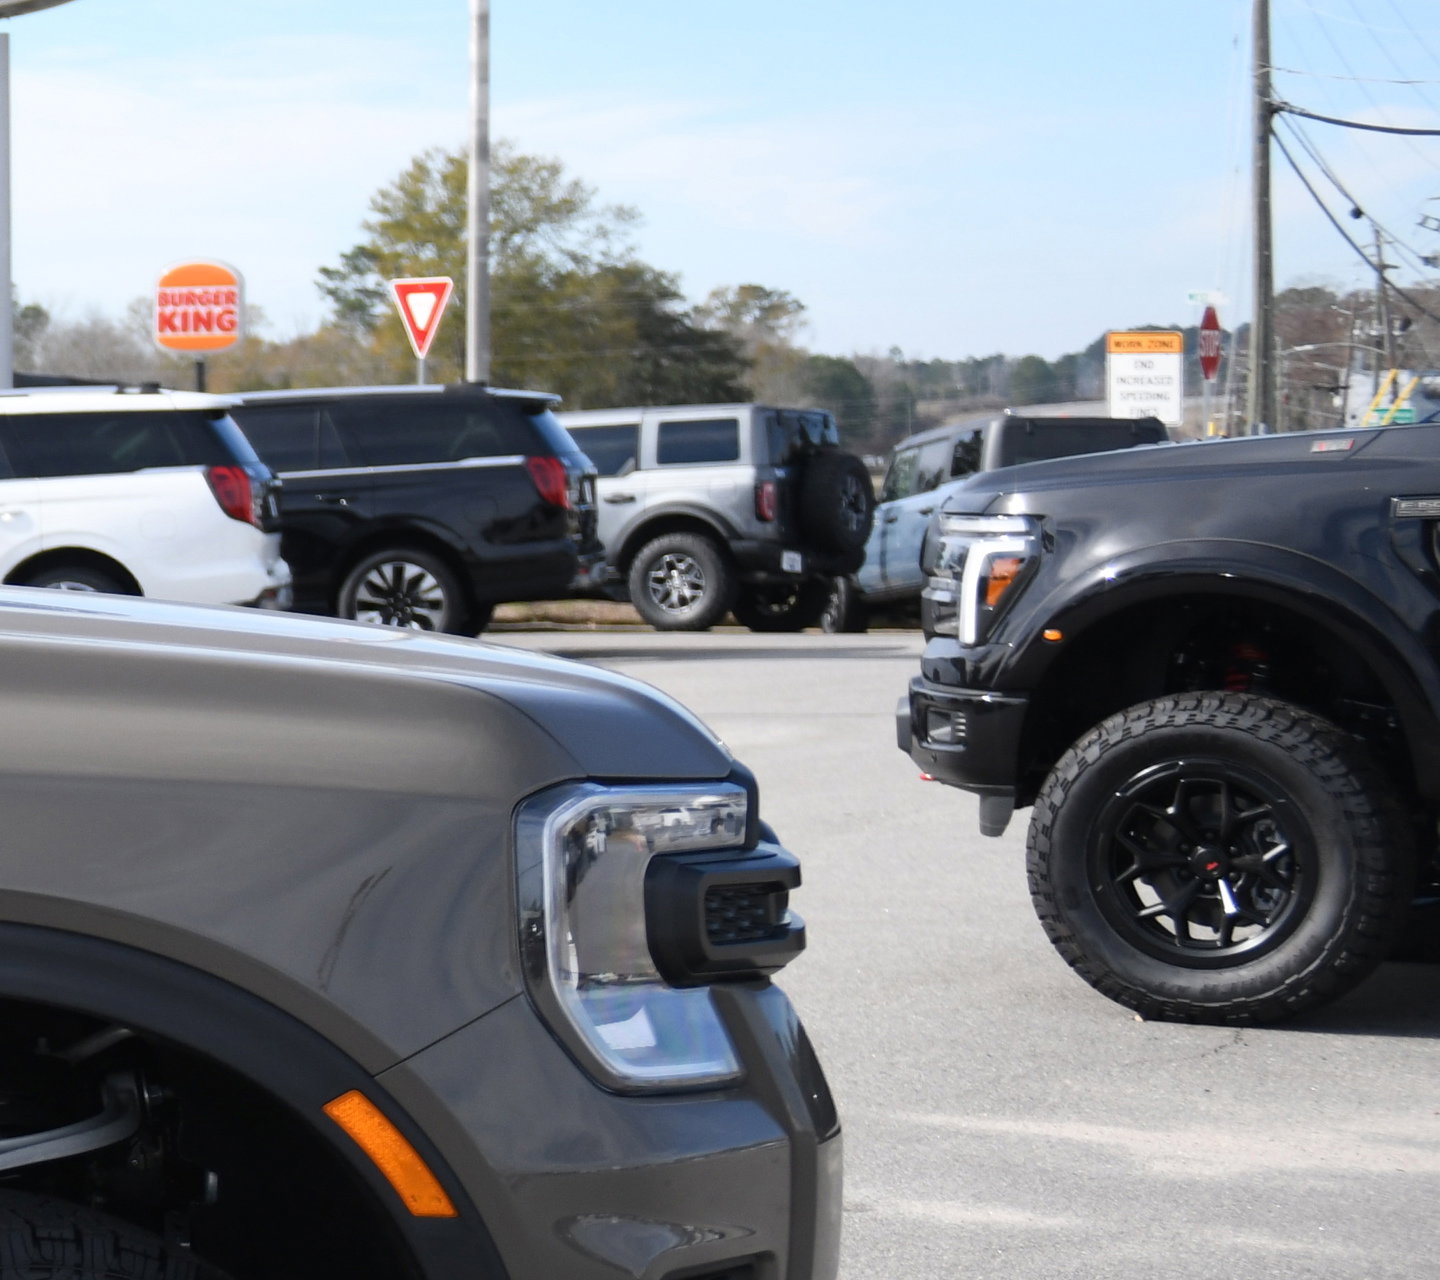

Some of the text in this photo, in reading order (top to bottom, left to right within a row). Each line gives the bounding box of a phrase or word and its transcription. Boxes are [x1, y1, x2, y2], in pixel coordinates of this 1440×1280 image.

[158, 291, 236, 307] BURGER
[158, 310, 237, 333] KING
[1114, 340, 1173, 348] WORK ZONE
[1200, 330, 1219, 357] STOP
[1133, 360, 1154, 369] END
[1116, 375, 1174, 385] INCREASED
[1119, 392, 1170, 401] SPEEDING
